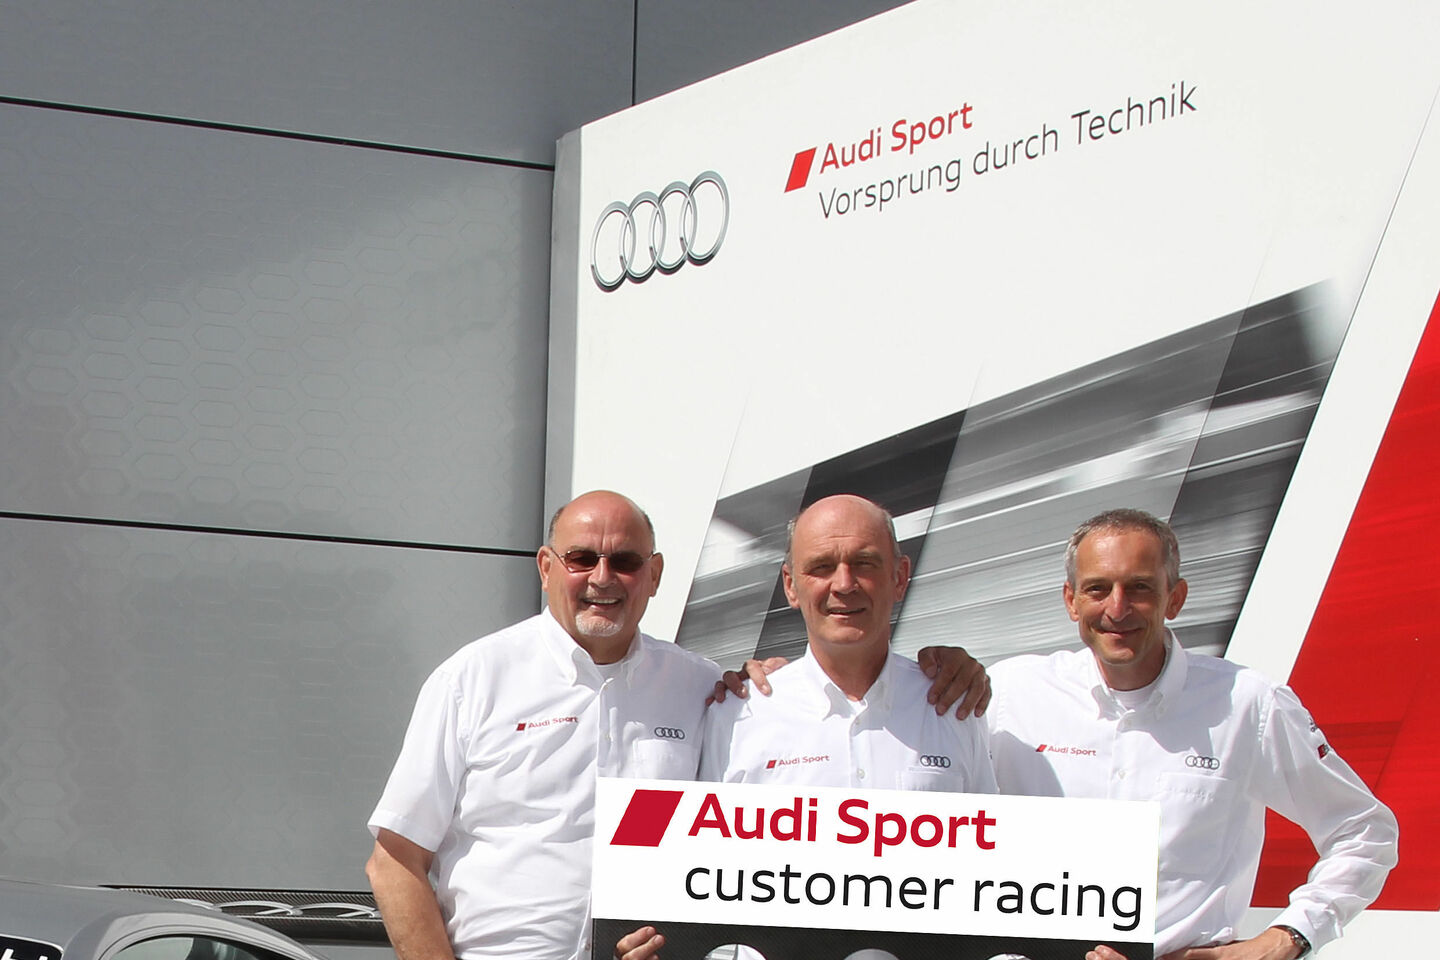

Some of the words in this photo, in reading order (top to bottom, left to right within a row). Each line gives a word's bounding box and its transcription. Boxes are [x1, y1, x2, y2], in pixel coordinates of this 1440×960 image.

[818, 155, 962, 219] Vorsprung
[972, 123, 1059, 176] durch
[1070, 81, 1198, 146] Technik
[819, 128, 882, 174] Audi
[890, 101, 974, 154] Sport
[528, 719, 551, 729] Audi
[552, 715, 579, 724] Sport
[1047, 745, 1069, 754] Audi
[1070, 746, 1097, 757] Sport
[778, 757, 801, 767] Audi
[802, 754, 831, 764] Sport
[688, 792, 818, 842] Audi
[836, 798, 997, 857] Sport
[684, 863, 955, 911] customer
[972, 871, 1143, 931] racing
